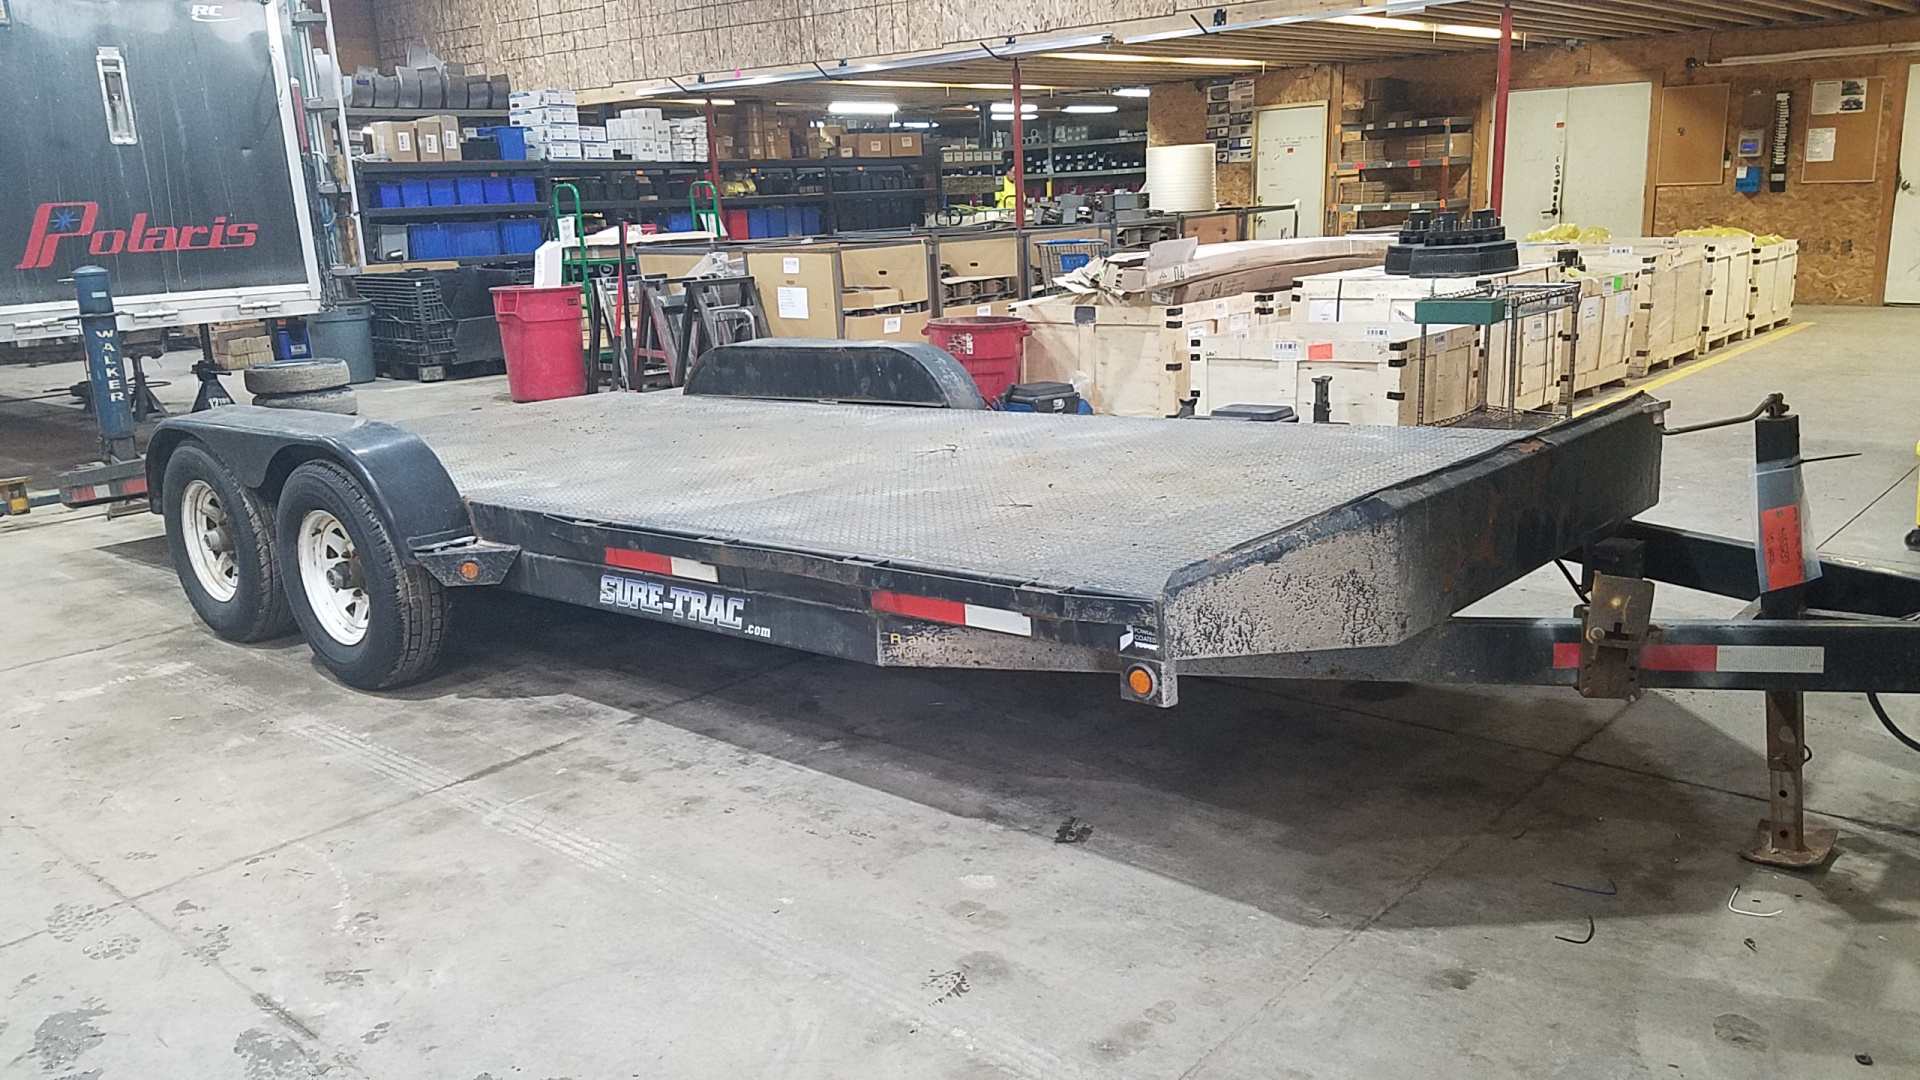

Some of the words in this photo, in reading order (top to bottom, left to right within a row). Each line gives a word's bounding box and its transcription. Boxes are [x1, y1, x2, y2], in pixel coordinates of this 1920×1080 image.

[191, 4, 223, 16] RC
[14, 201, 259, 269] Polaris
[95, 329, 125, 403] WALKER
[599, 574, 745, 630] SURE-TRAC
